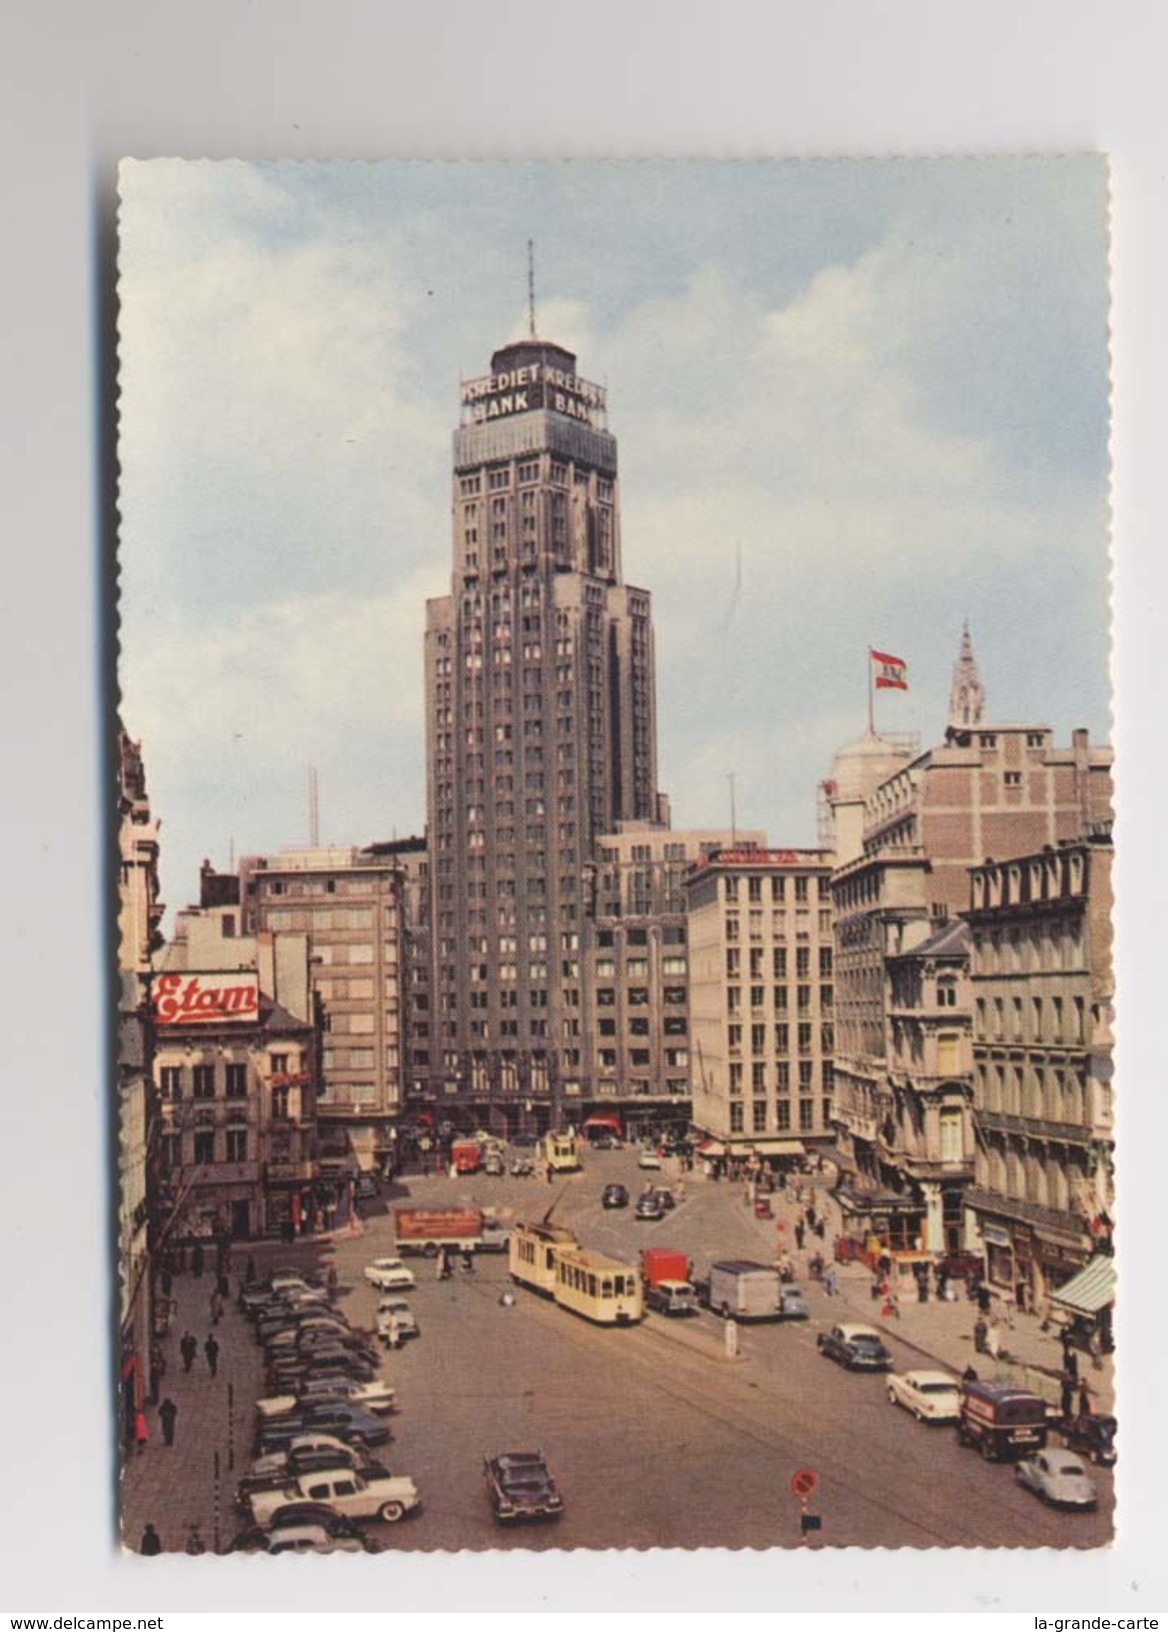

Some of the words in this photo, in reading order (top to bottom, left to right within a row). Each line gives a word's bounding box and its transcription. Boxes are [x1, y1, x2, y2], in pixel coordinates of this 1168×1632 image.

[473, 391, 529, 420] BANK
[555, 392, 594, 422] BAN
[152, 973, 258, 1024] Etam
